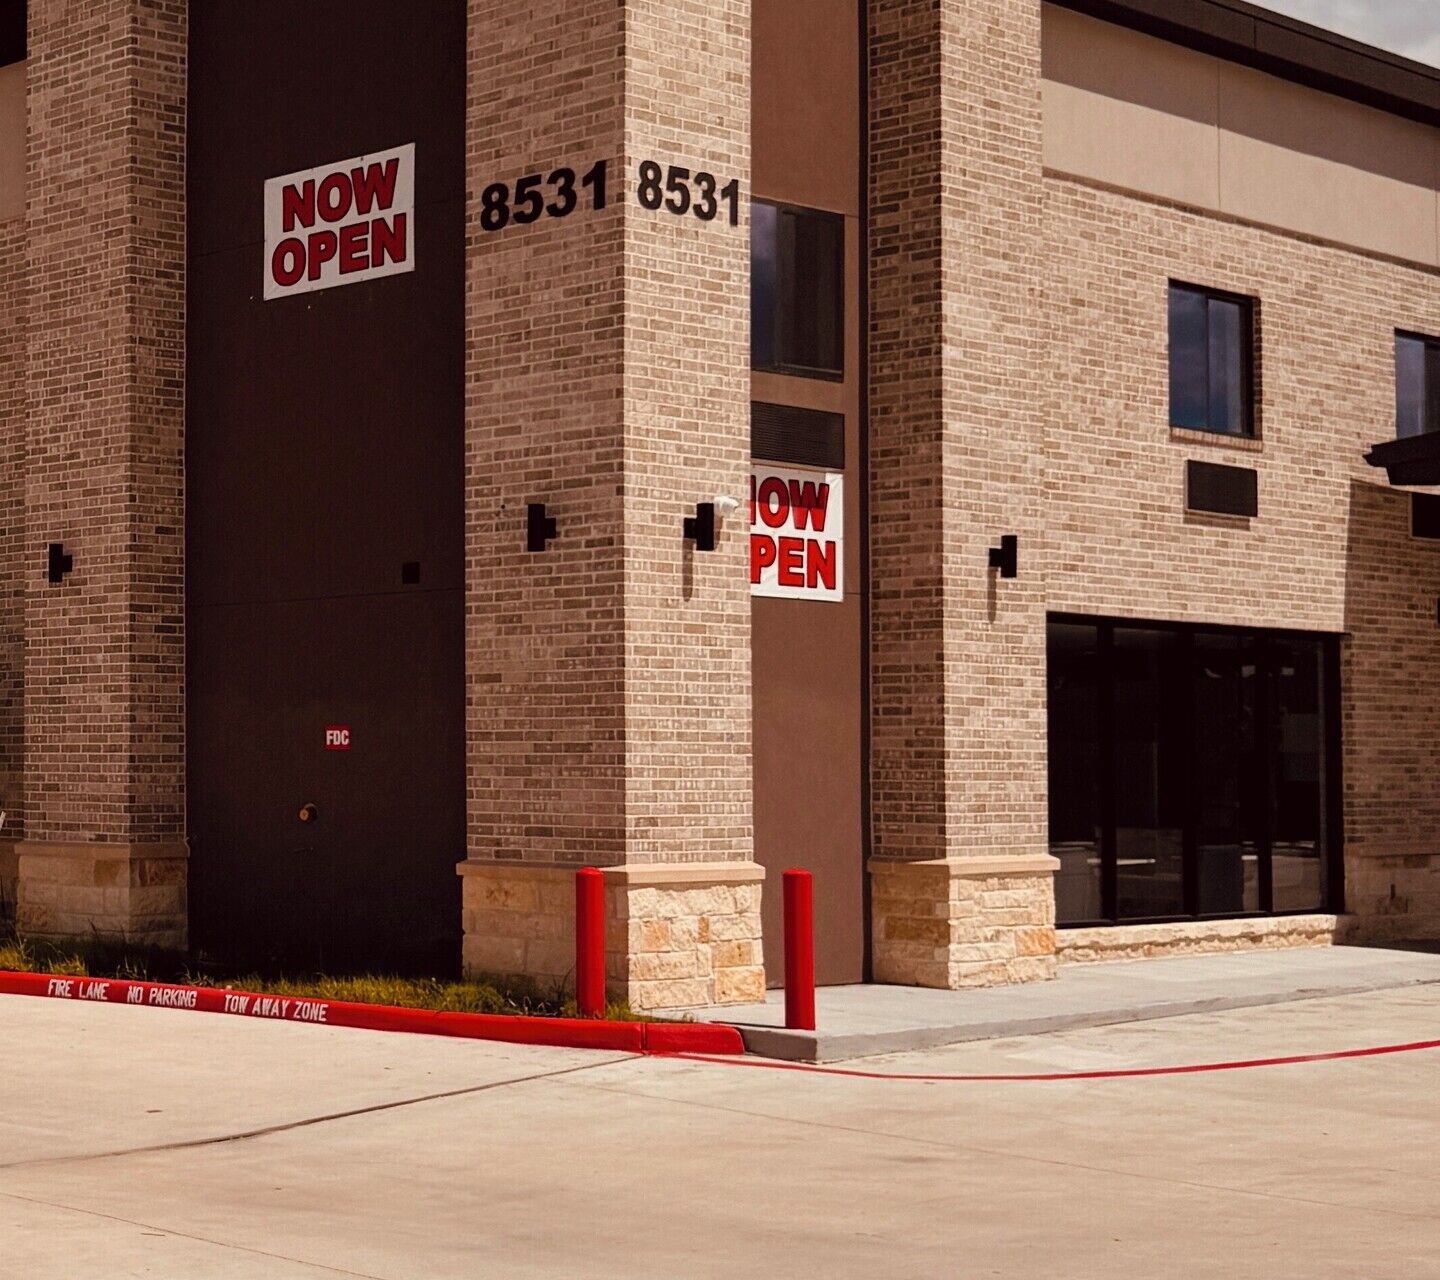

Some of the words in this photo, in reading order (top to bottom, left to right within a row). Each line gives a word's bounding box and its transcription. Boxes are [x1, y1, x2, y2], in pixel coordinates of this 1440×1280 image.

[283, 158, 399, 233] NOW
[481, 160, 607, 231] 8531
[638, 160, 738, 227] 8531
[272, 213, 406, 286] OPEN
[750, 475, 830, 532] OW
[750, 533, 836, 590] PEN
[326, 730, 349, 745] FDC
[48, 979, 71, 998] FIRE
[79, 982, 109, 1001] LANE
[127, 985, 143, 1003] NO
[149, 987, 197, 1008] PARKING
[225, 994, 248, 1014] TOW
[252, 997, 289, 1018] AWAY
[293, 1001, 328, 1022] ZONE
